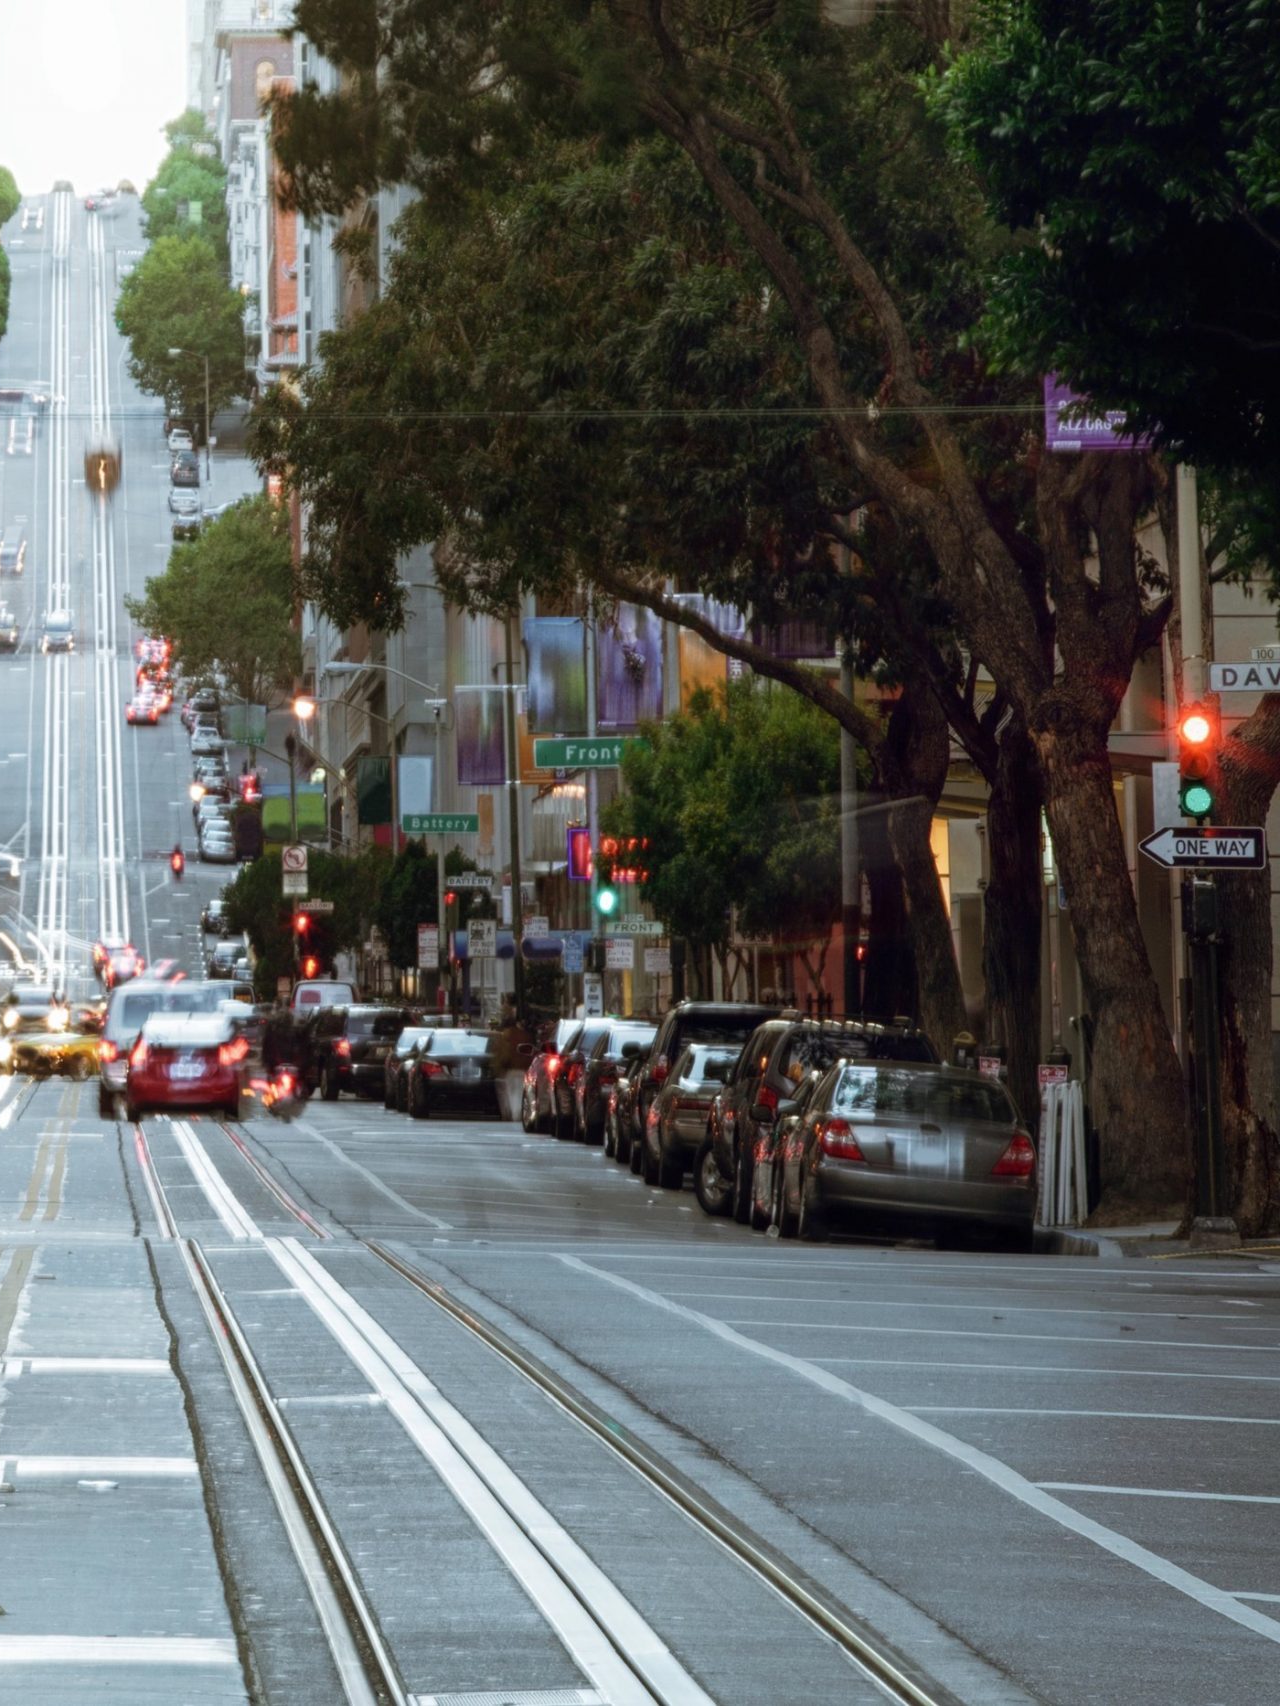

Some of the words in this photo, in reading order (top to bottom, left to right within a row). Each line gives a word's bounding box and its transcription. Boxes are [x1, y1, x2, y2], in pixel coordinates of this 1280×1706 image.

[1256, 648, 1275, 660] 100
[1222, 667, 1280, 687] DAV
[565, 744, 621, 761] Front
[411, 817, 470, 831] Battery
[1175, 840, 1208, 856] ONE
[1215, 839, 1250, 856] WAY
[449, 877, 490, 885] BATTERY
[614, 923, 654, 931] FRONT
